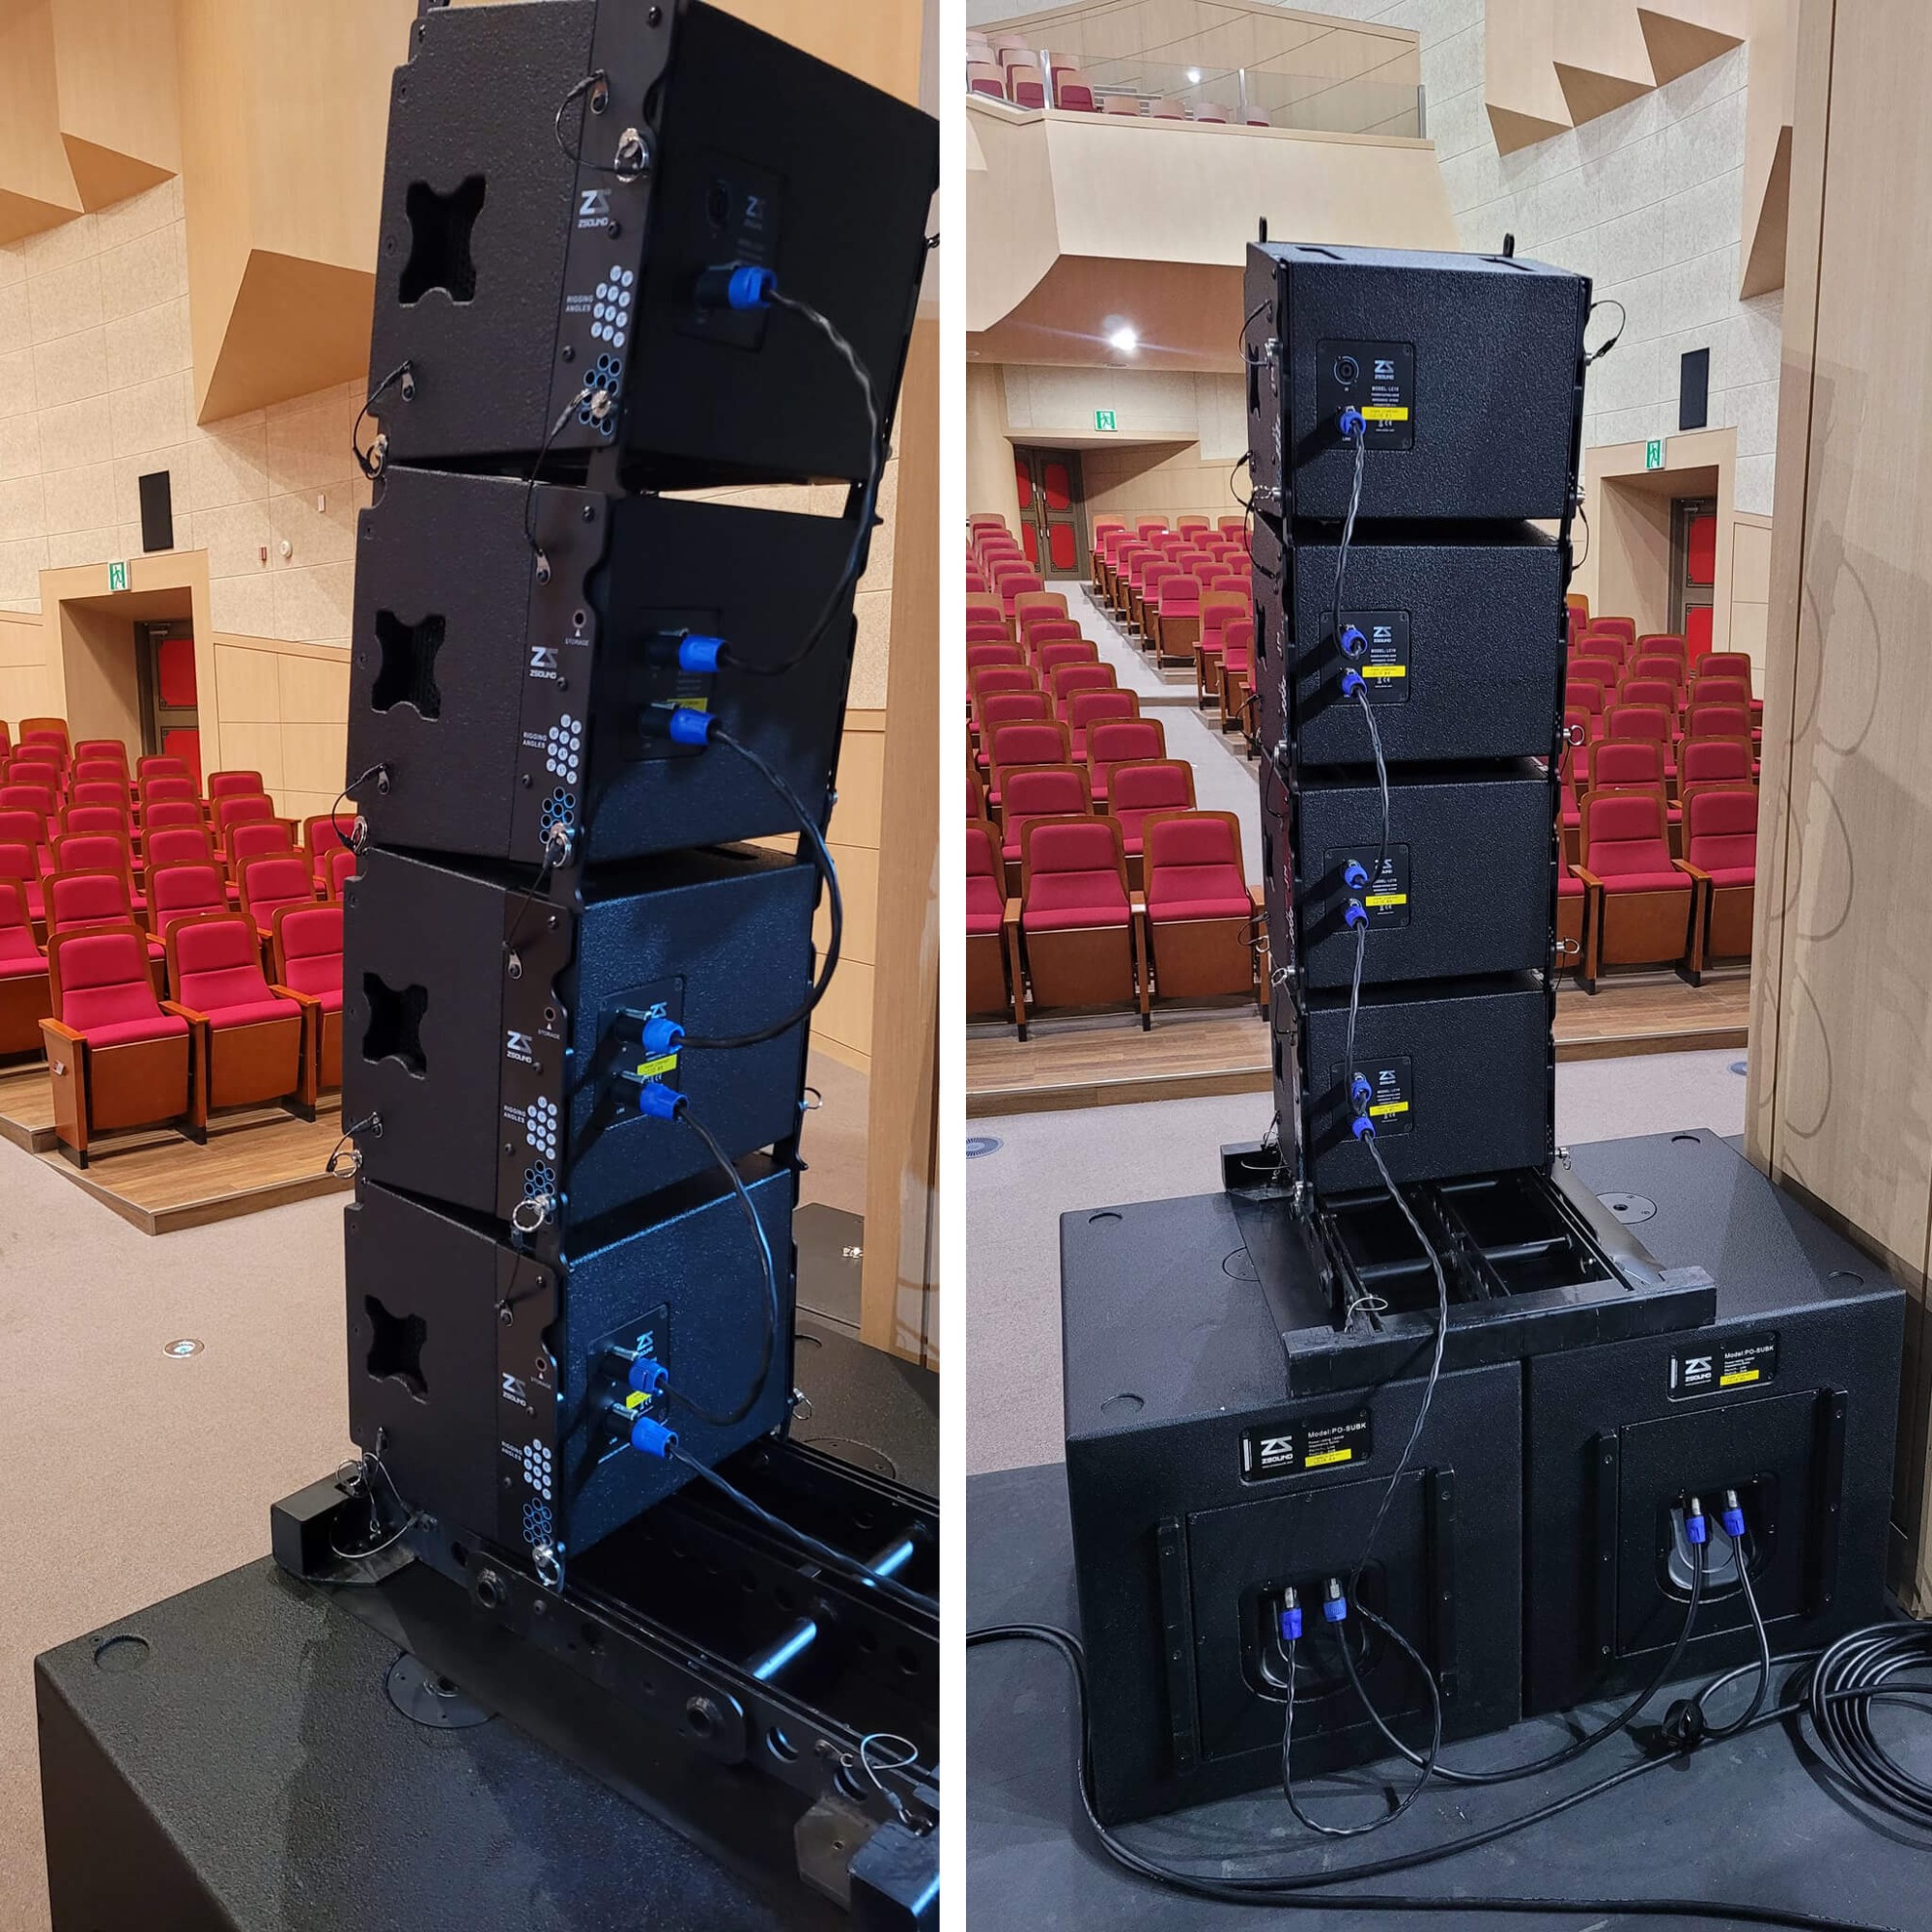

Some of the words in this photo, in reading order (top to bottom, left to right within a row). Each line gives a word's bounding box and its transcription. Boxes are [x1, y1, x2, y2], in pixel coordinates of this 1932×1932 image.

[578, 216, 609, 229] ZSOUND
[566, 295, 593, 303] RIGGING
[566, 304, 591, 313] ANGLES
[565, 638, 589, 646] STORAGE
[529, 669, 556, 680] ZSOUND
[524, 732, 547, 742] RIGGING
[523, 740, 545, 749] ANGLES
[538, 1029, 560, 1039] STORAGE
[507, 1051, 532, 1064] ZSOUND
[504, 1105, 526, 1117] RIGGING
[504, 1112, 525, 1123] ANGLES
[531, 1377, 552, 1389] STORAGE
[1685, 1373, 1712, 1382] ZSOUND
[503, 1392, 526, 1407] ZSOUND
[501, 1441, 523, 1455] RIGGING
[501, 1448, 522, 1461] ANGLES
[1262, 1453, 1293, 1464] ZSOUND
